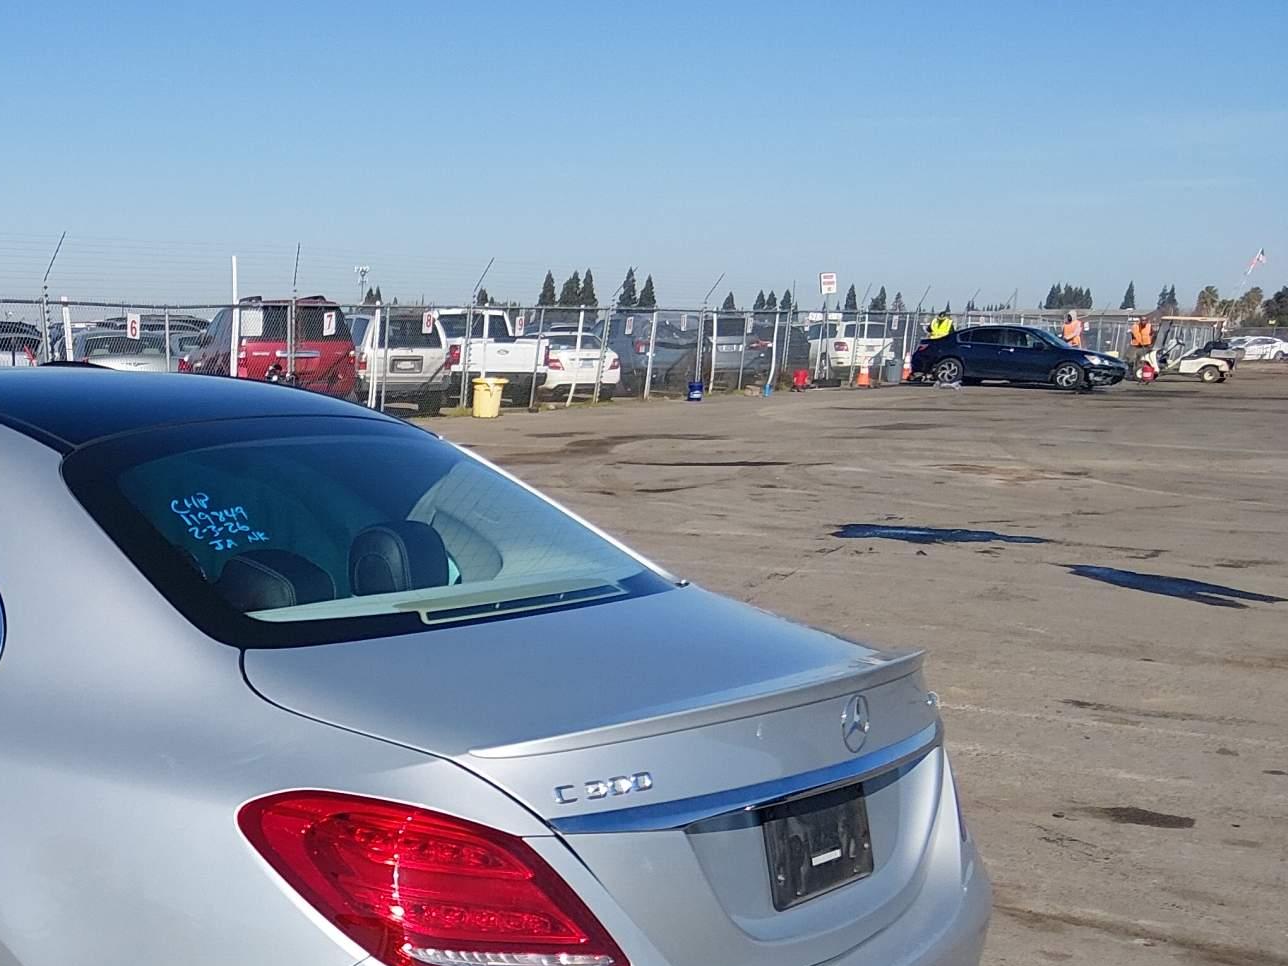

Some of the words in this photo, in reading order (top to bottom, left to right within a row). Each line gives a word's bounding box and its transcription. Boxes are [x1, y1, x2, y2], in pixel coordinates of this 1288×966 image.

[129, 319, 138, 337] 6
[325, 314, 334, 329] 7
[425, 313, 432, 328] 8
[518, 317, 524, 331] 9
[554, 784, 579, 805] C
